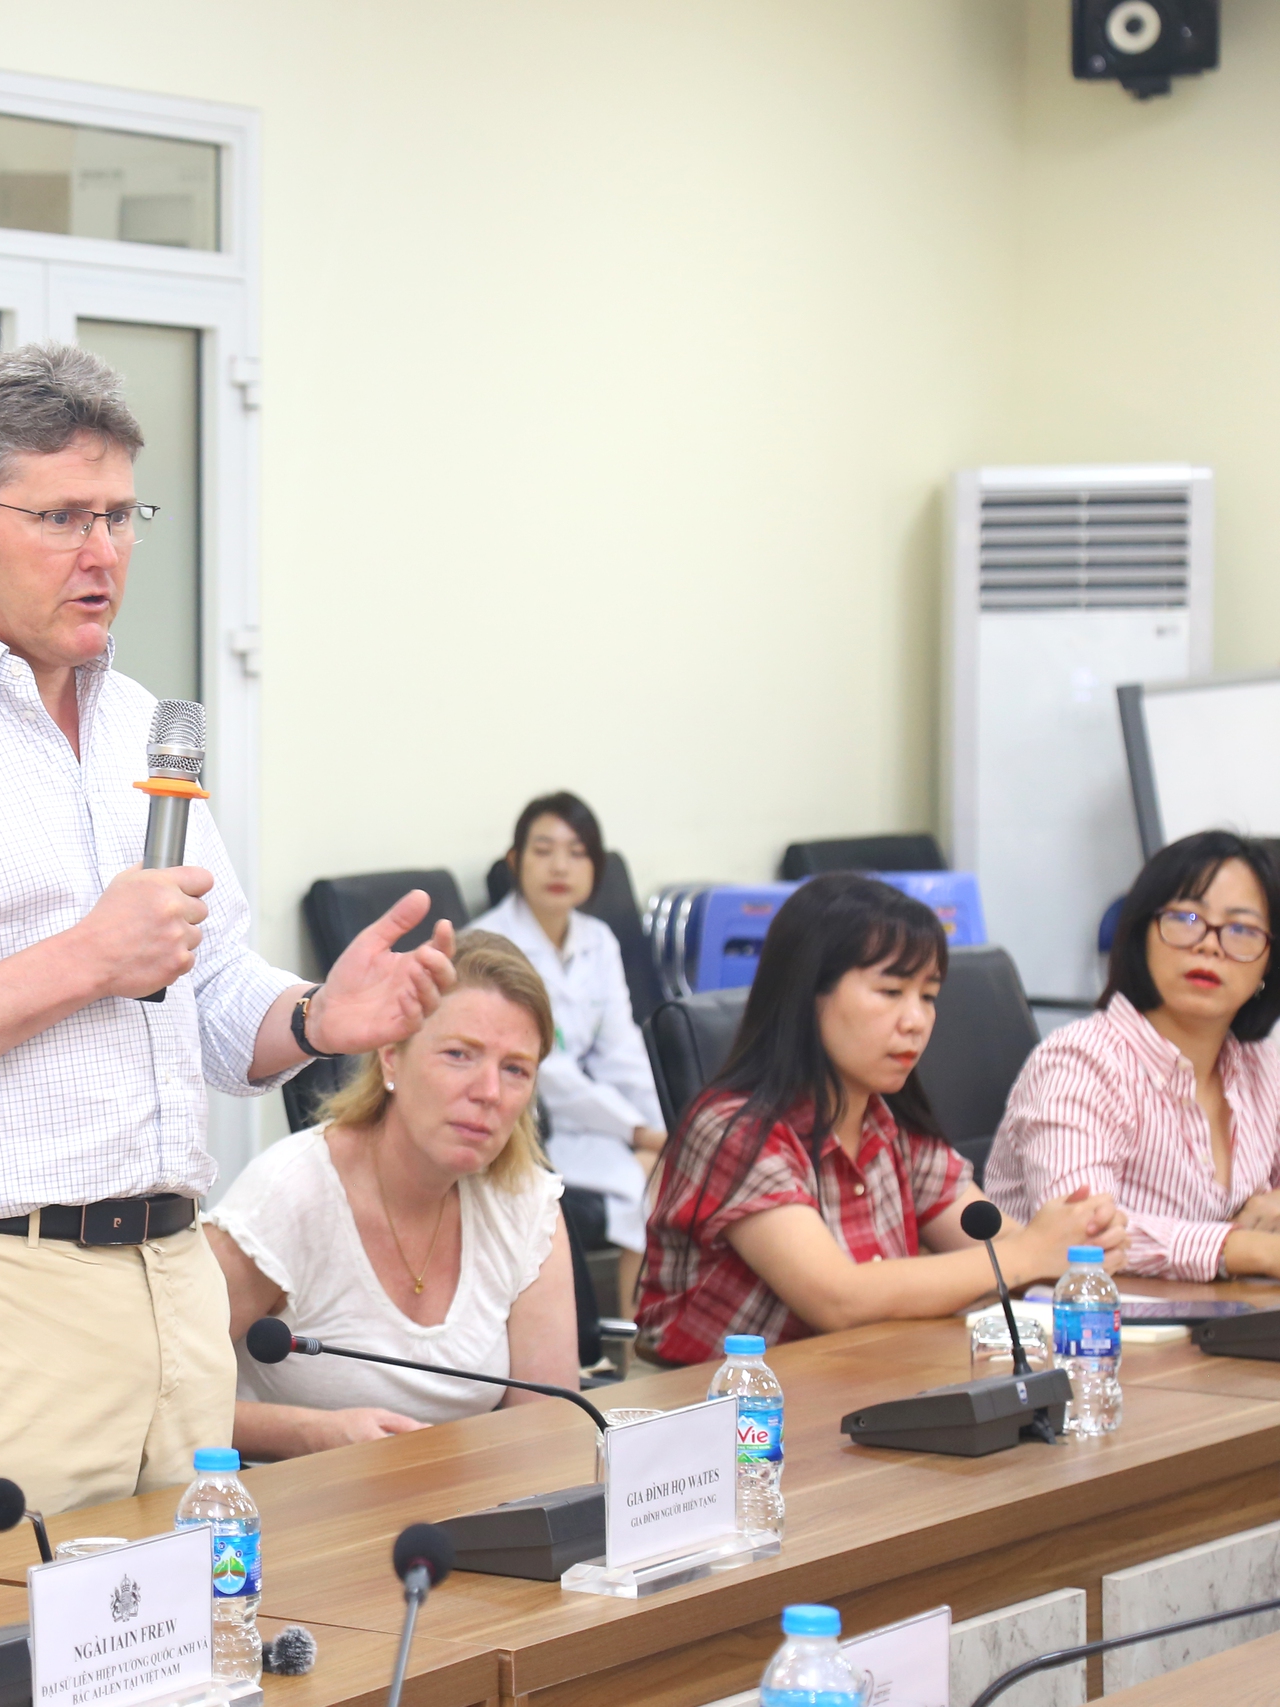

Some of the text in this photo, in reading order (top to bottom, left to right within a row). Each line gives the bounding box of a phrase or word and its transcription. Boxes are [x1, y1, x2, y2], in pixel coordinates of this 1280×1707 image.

[626, 1468, 720, 1508] GIA ĐÌNH HỌ WATES
[630, 1516, 643, 1528] GIA
[643, 1510, 660, 1524] ĐÌNH
[698, 1493, 717, 1508] TẠNG
[74, 1618, 178, 1662] NGÀI IAIN FREW
[41, 1682, 58, 1698] ĐẠI
[73, 1670, 94, 1688] LIÊN
[95, 1665, 117, 1681] HIỆP
[150, 1646, 175, 1667] QUỐC
[176, 1641, 195, 1657] ANH
[196, 1635, 208, 1650] VÀ
[92, 1680, 122, 1700] AI-LEN
[123, 1675, 138, 1691] TẠI
[140, 1668, 159, 1685] VIỆT
[160, 1662, 181, 1679] NAM
